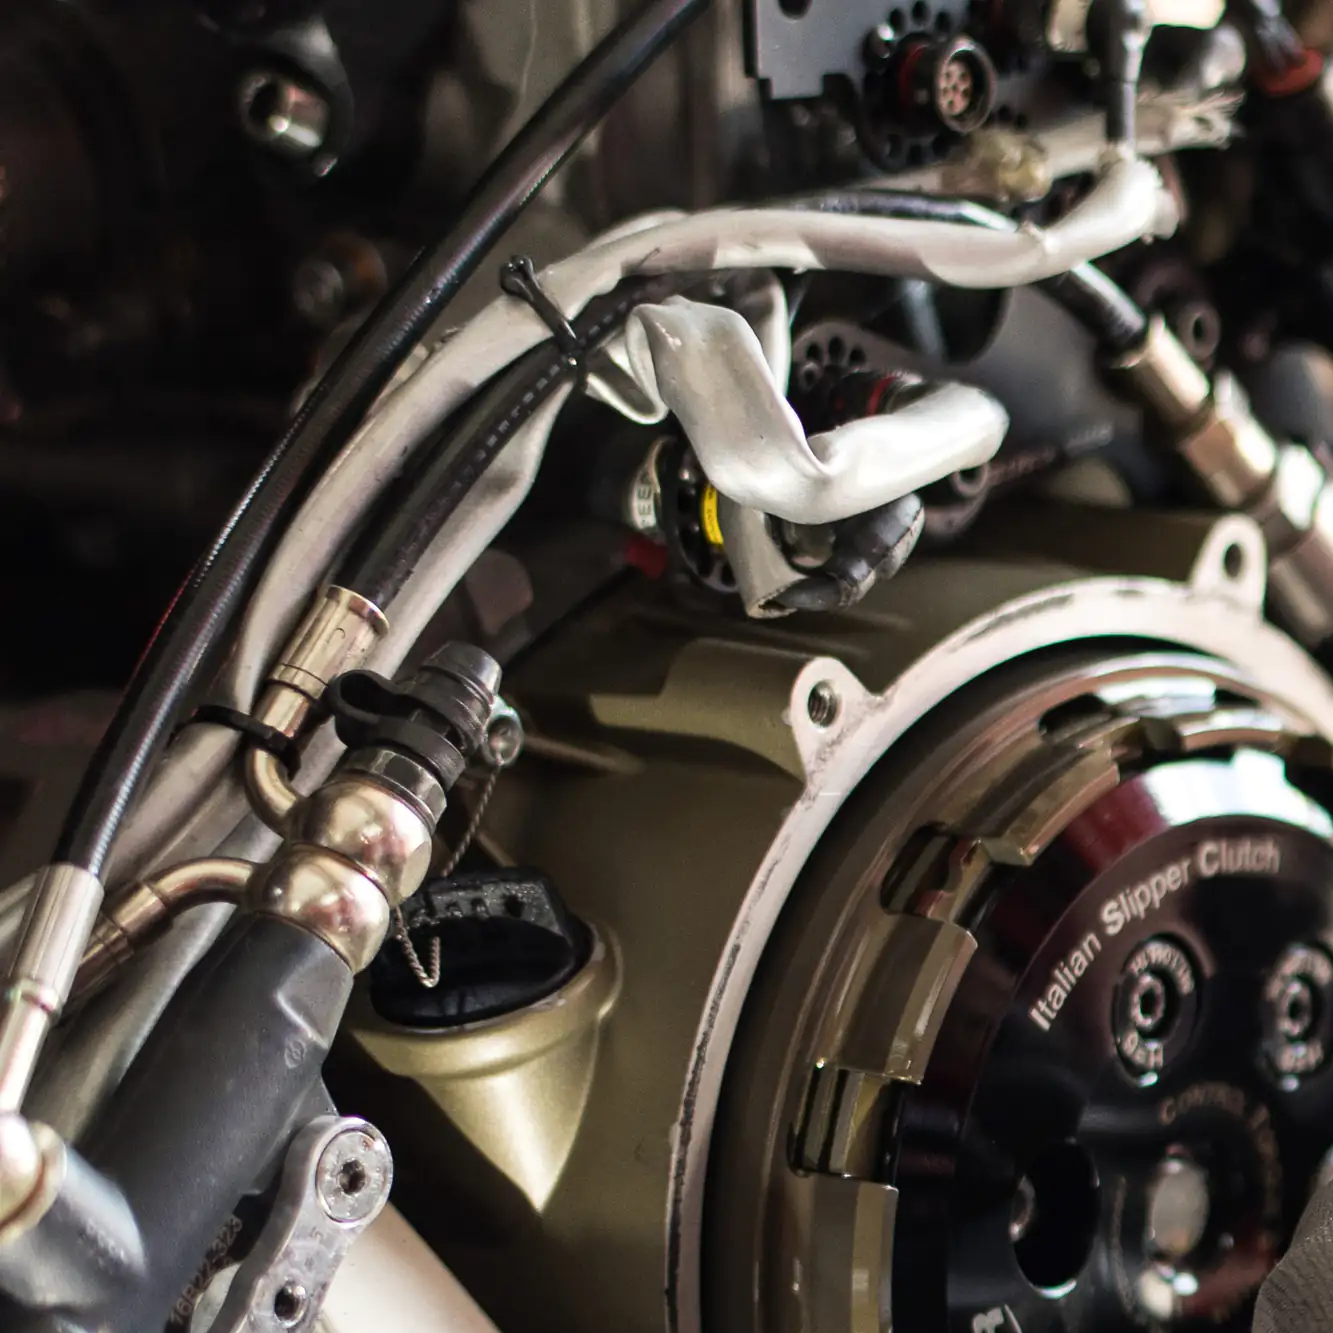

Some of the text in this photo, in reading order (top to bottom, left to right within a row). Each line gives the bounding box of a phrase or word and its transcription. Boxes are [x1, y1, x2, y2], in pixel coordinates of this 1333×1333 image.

[1028, 932, 1102, 1031] Italian
[1100, 858, 1191, 936] Slipper
[1197, 838, 1281, 877] Clutch
